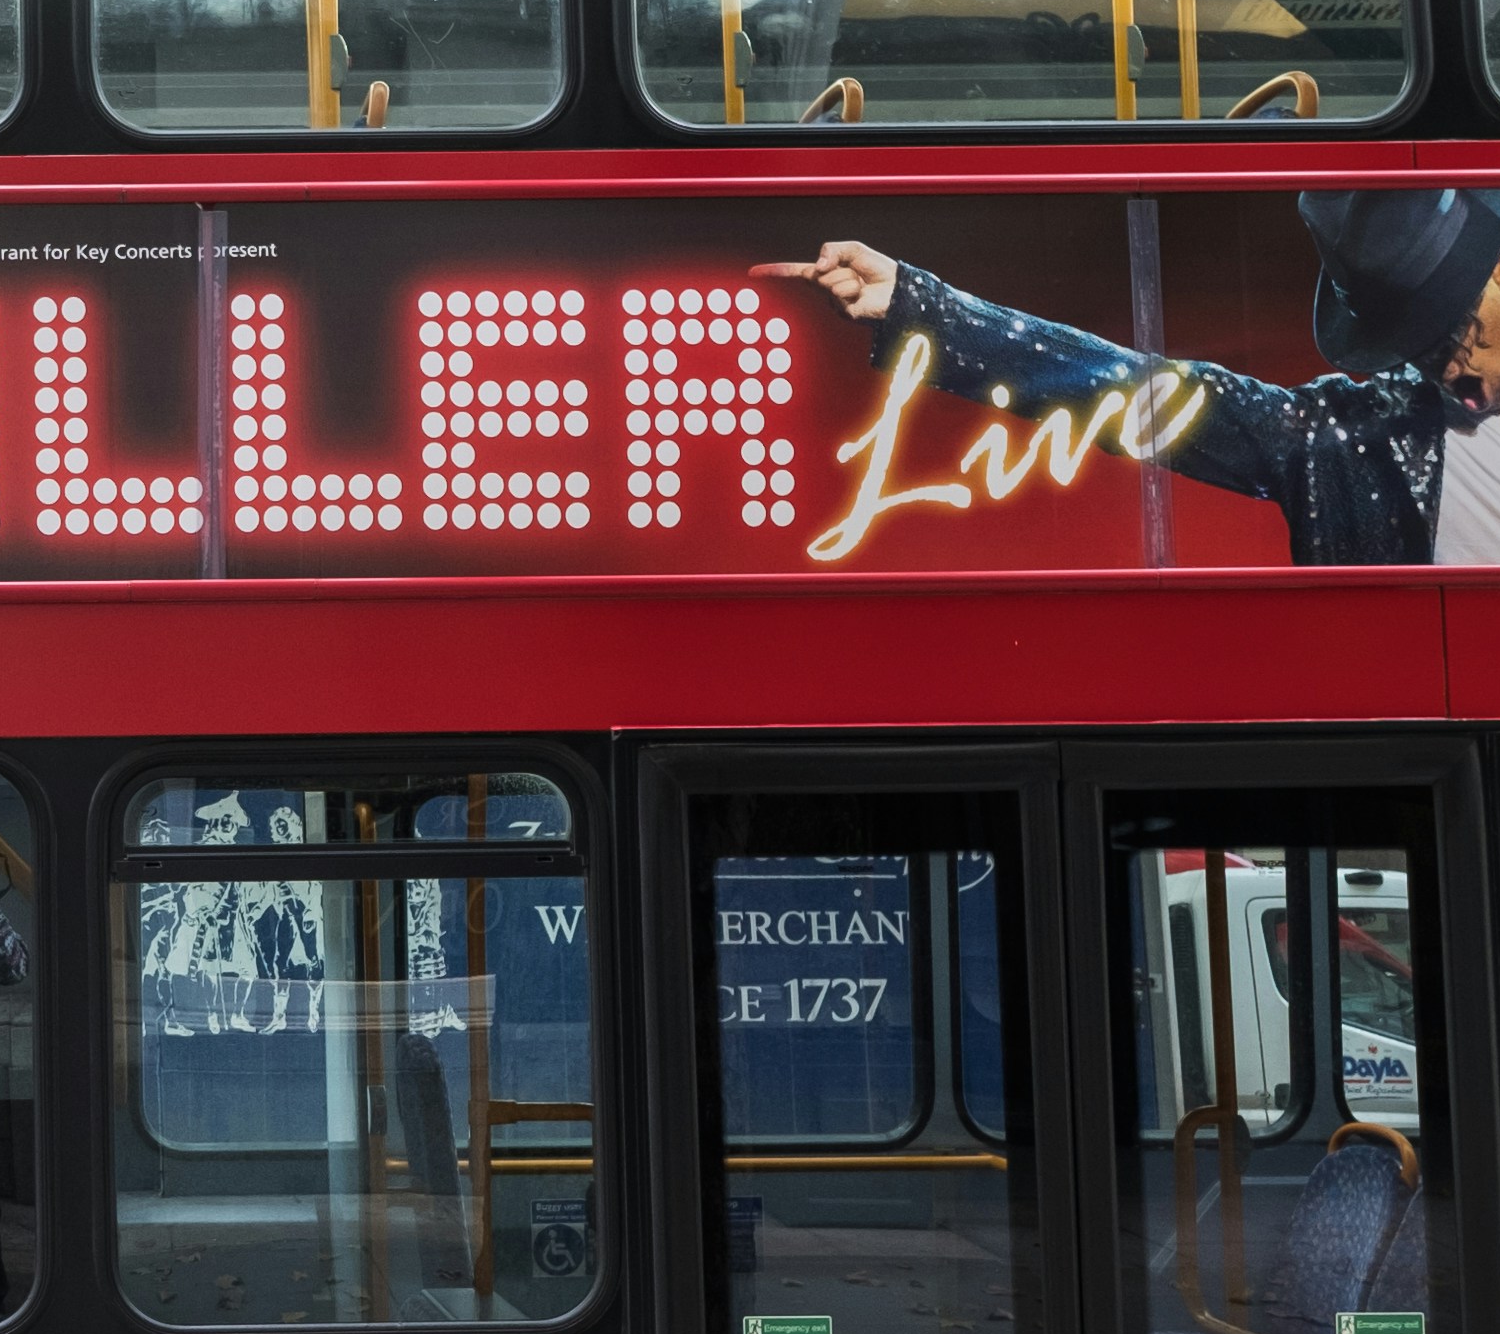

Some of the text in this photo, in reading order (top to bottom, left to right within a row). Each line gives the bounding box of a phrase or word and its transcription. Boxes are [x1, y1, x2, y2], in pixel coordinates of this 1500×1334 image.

[43, 243, 71, 261] for
[76, 243, 108, 264] Key
[114, 242, 193, 261] Concerts
[805, 333, 1207, 562] Live
[717, 909, 909, 946] ERCHAN
[783, 978, 888, 1023] 1737
[1342, 1055, 1409, 1083] Dayla
[763, 1323, 827, 1334] Emergency exit
[1356, 1320, 1403, 1331] Emergency
